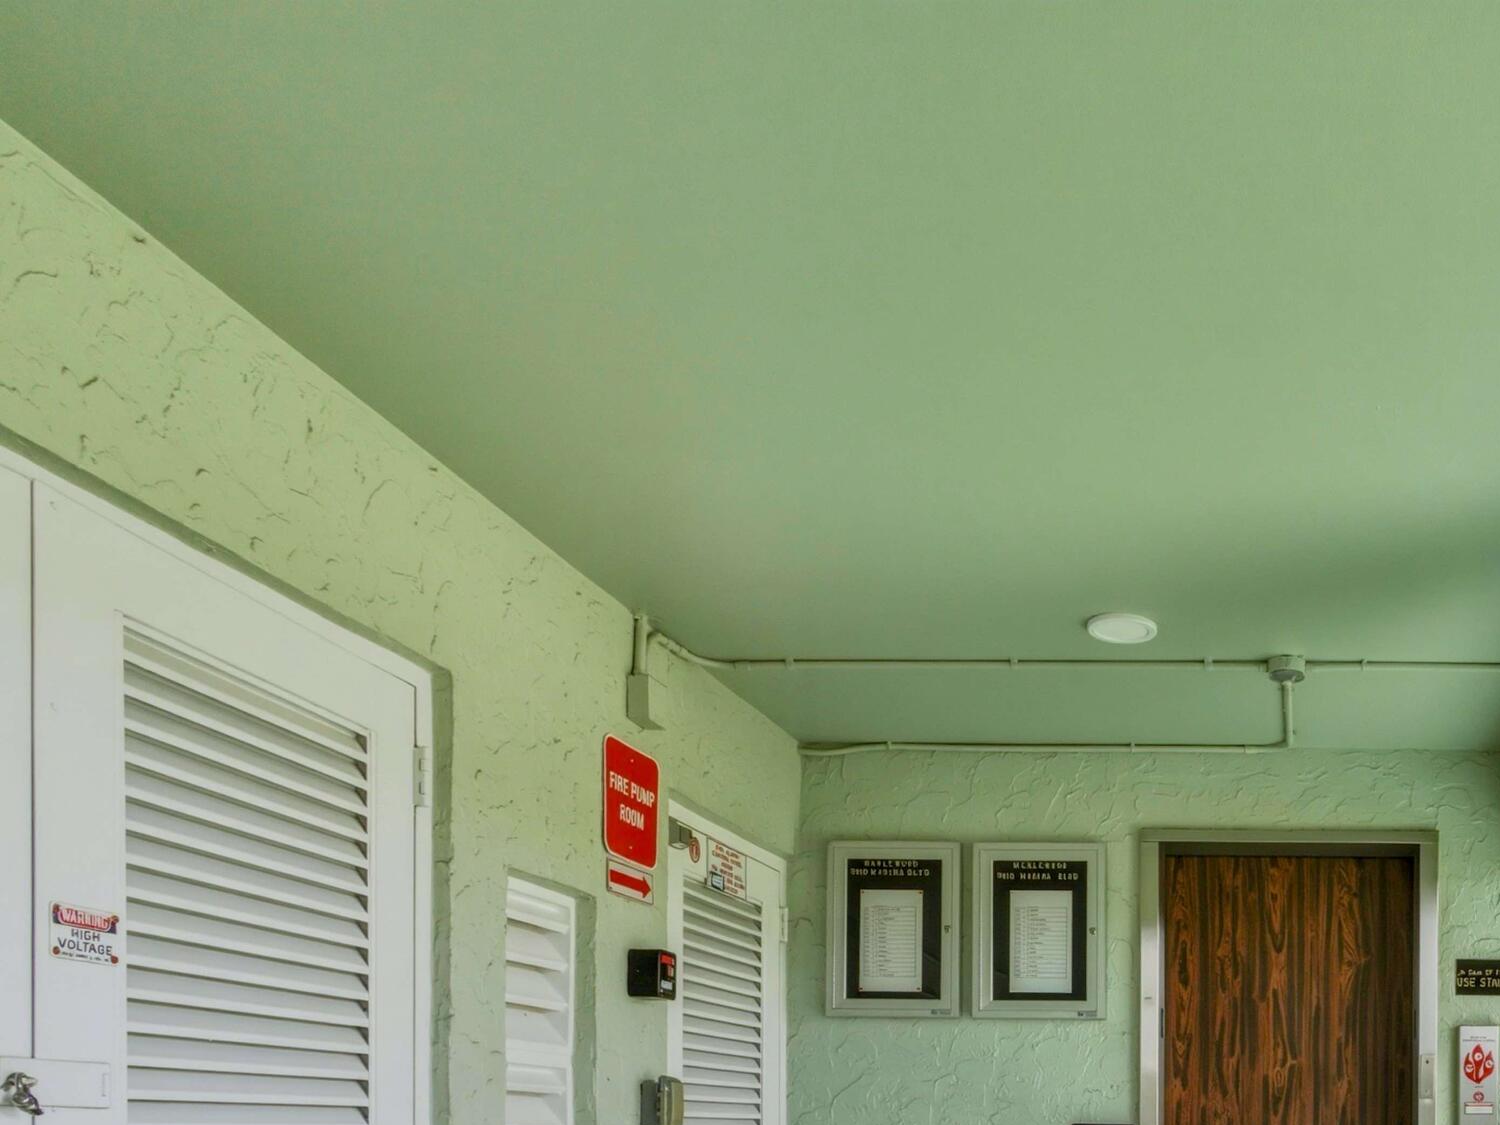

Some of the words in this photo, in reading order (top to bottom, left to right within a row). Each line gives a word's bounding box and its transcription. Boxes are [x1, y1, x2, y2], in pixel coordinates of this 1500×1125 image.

[610, 771, 629, 796] FIRE
[631, 781, 655, 808] PUMP
[620, 803, 644, 831] ROOM
[61, 908, 109, 930] WARNING
[71, 928, 101, 942] HIGH
[57, 937, 113, 957] VOLTAGE
[1456, 977, 1476, 987] USE
